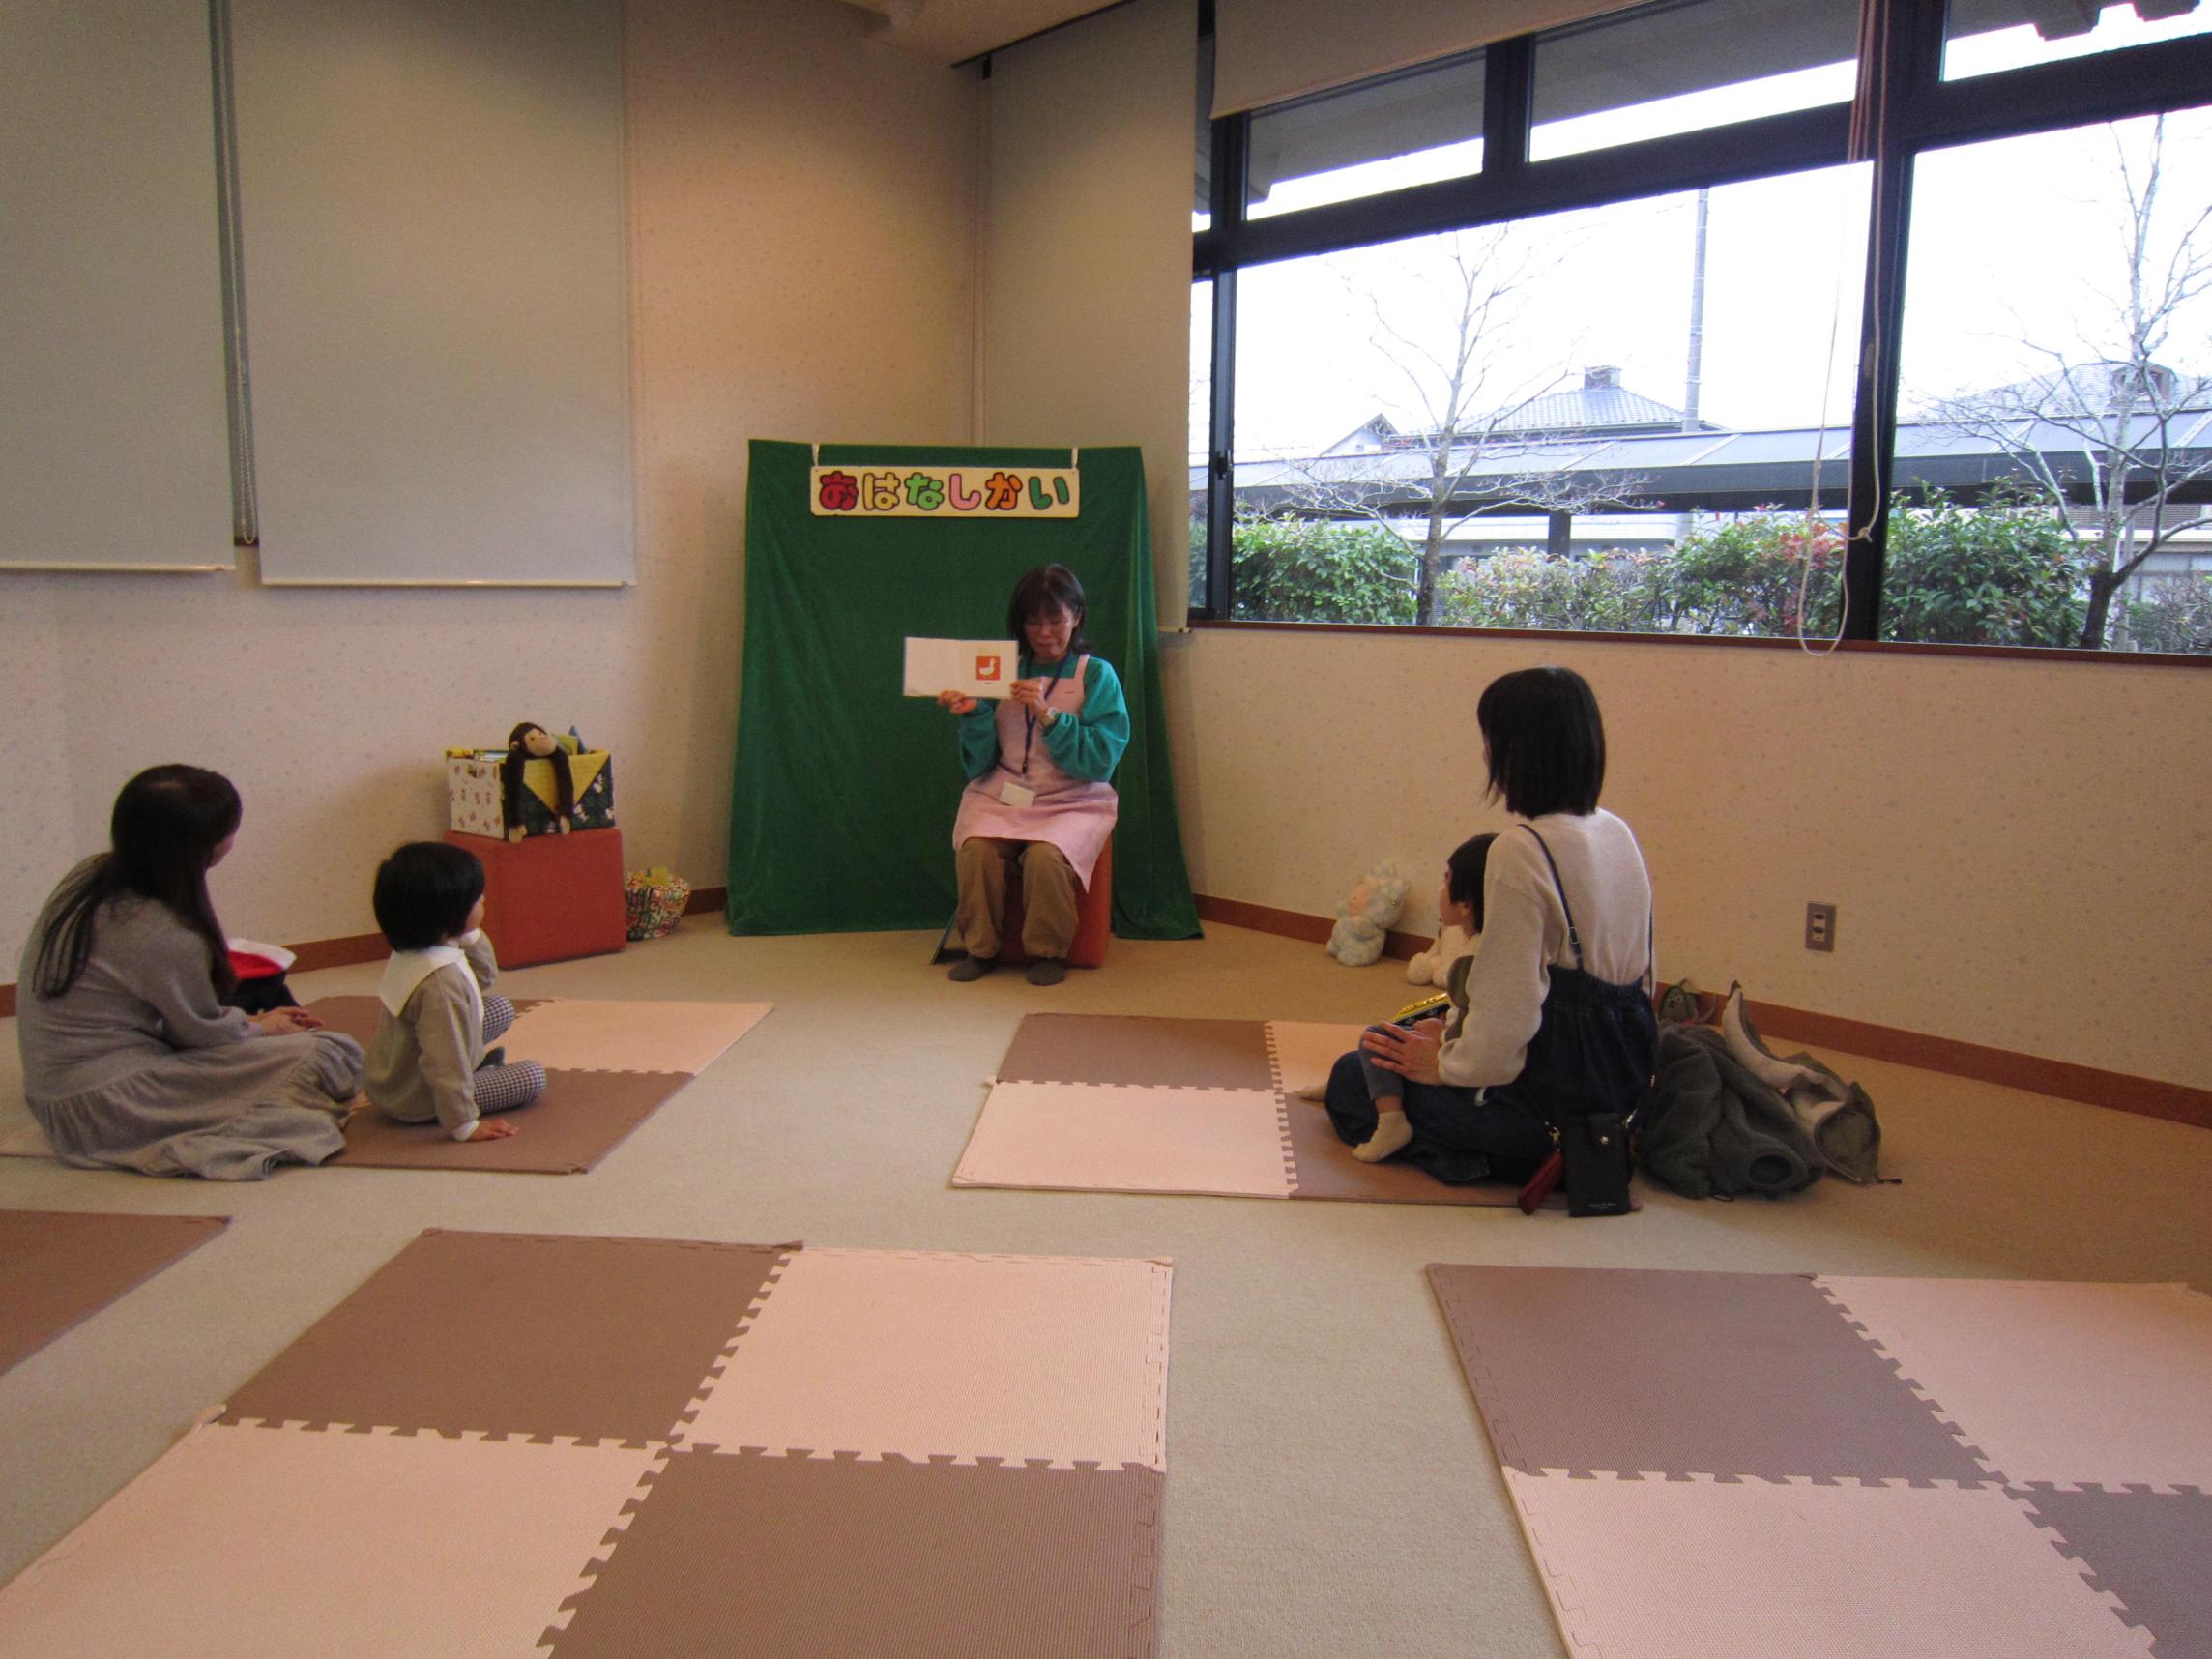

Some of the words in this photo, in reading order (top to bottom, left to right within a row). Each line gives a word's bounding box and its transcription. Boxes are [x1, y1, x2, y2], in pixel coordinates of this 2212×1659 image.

[819, 471, 1070, 511] おはなしかい
